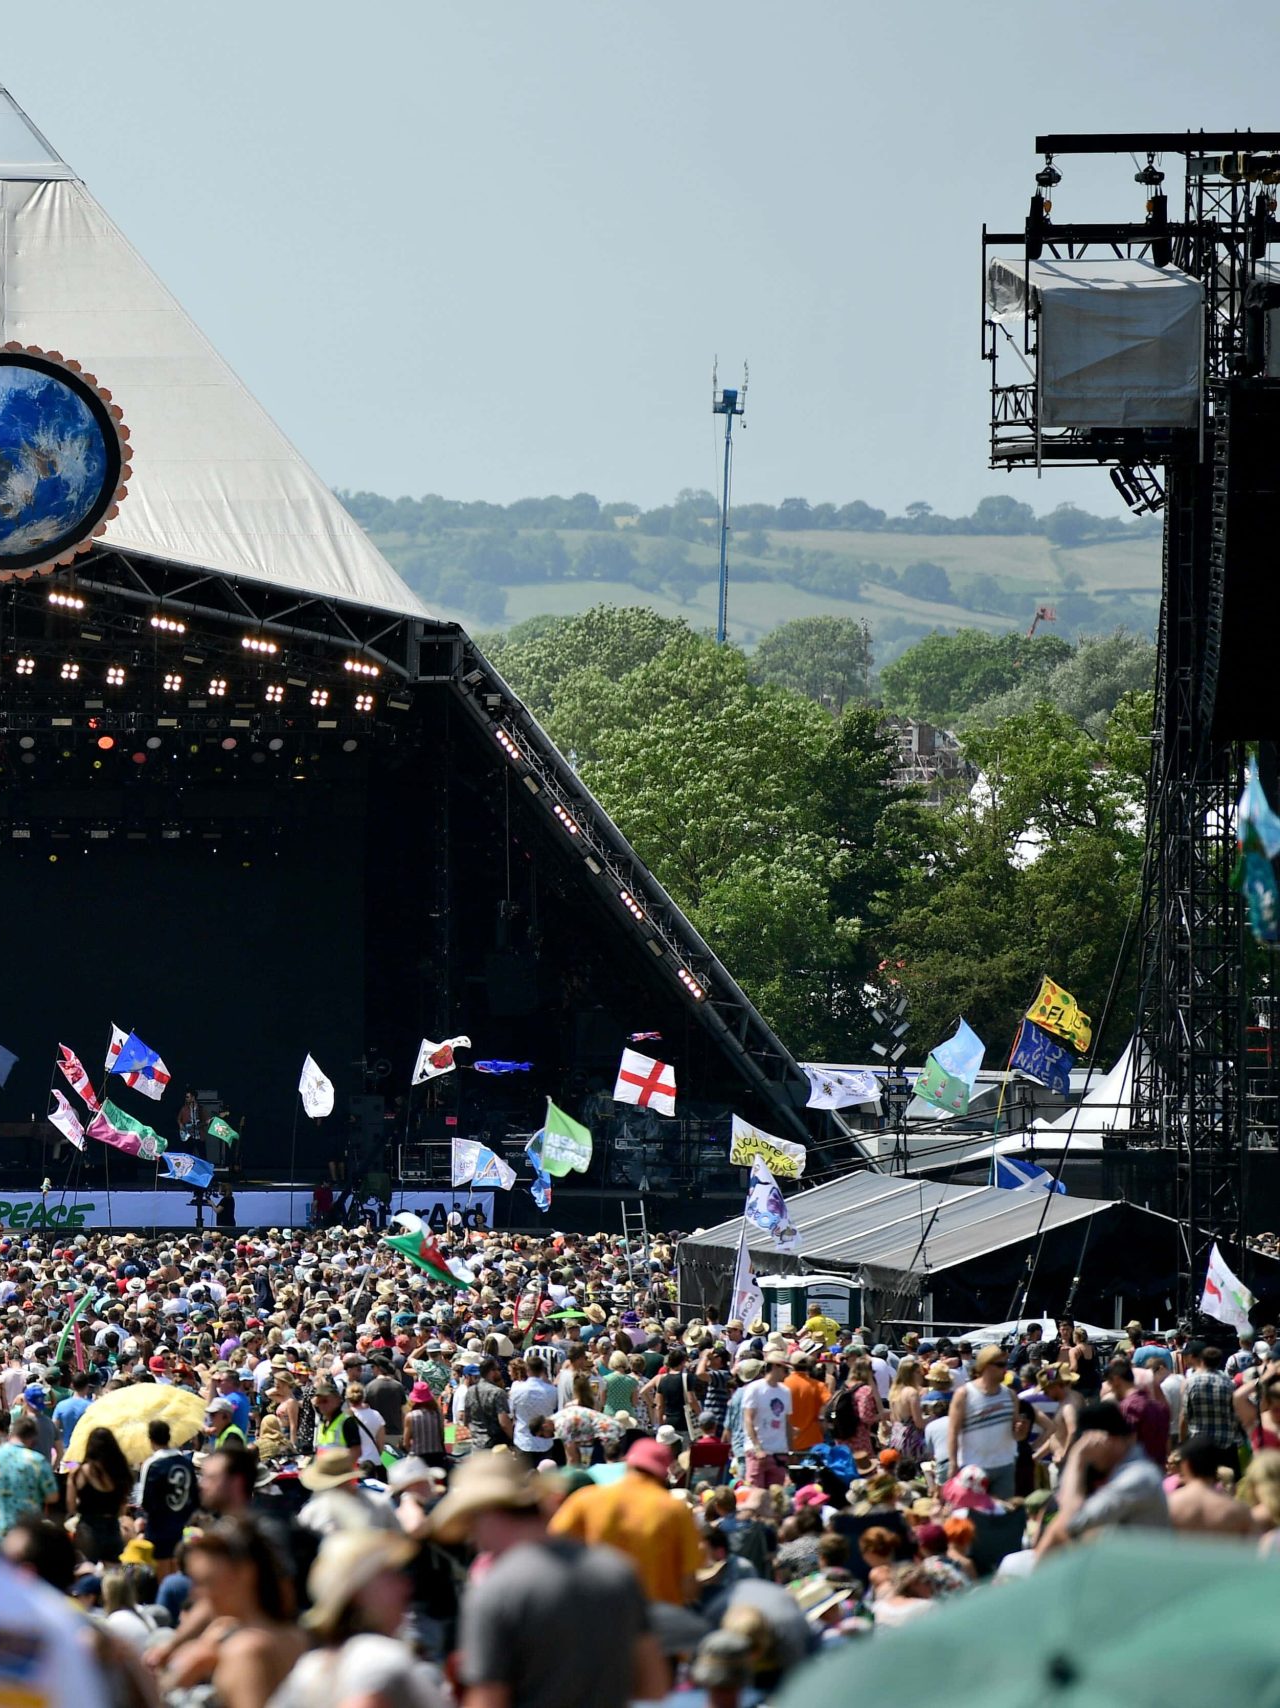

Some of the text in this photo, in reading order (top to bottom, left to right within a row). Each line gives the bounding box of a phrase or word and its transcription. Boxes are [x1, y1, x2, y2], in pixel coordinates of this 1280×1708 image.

[1032, 1046, 1058, 1073] GT
[737, 1137, 759, 1156] you
[760, 1140, 783, 1158] are
[166, 1464, 191, 1512] 3
